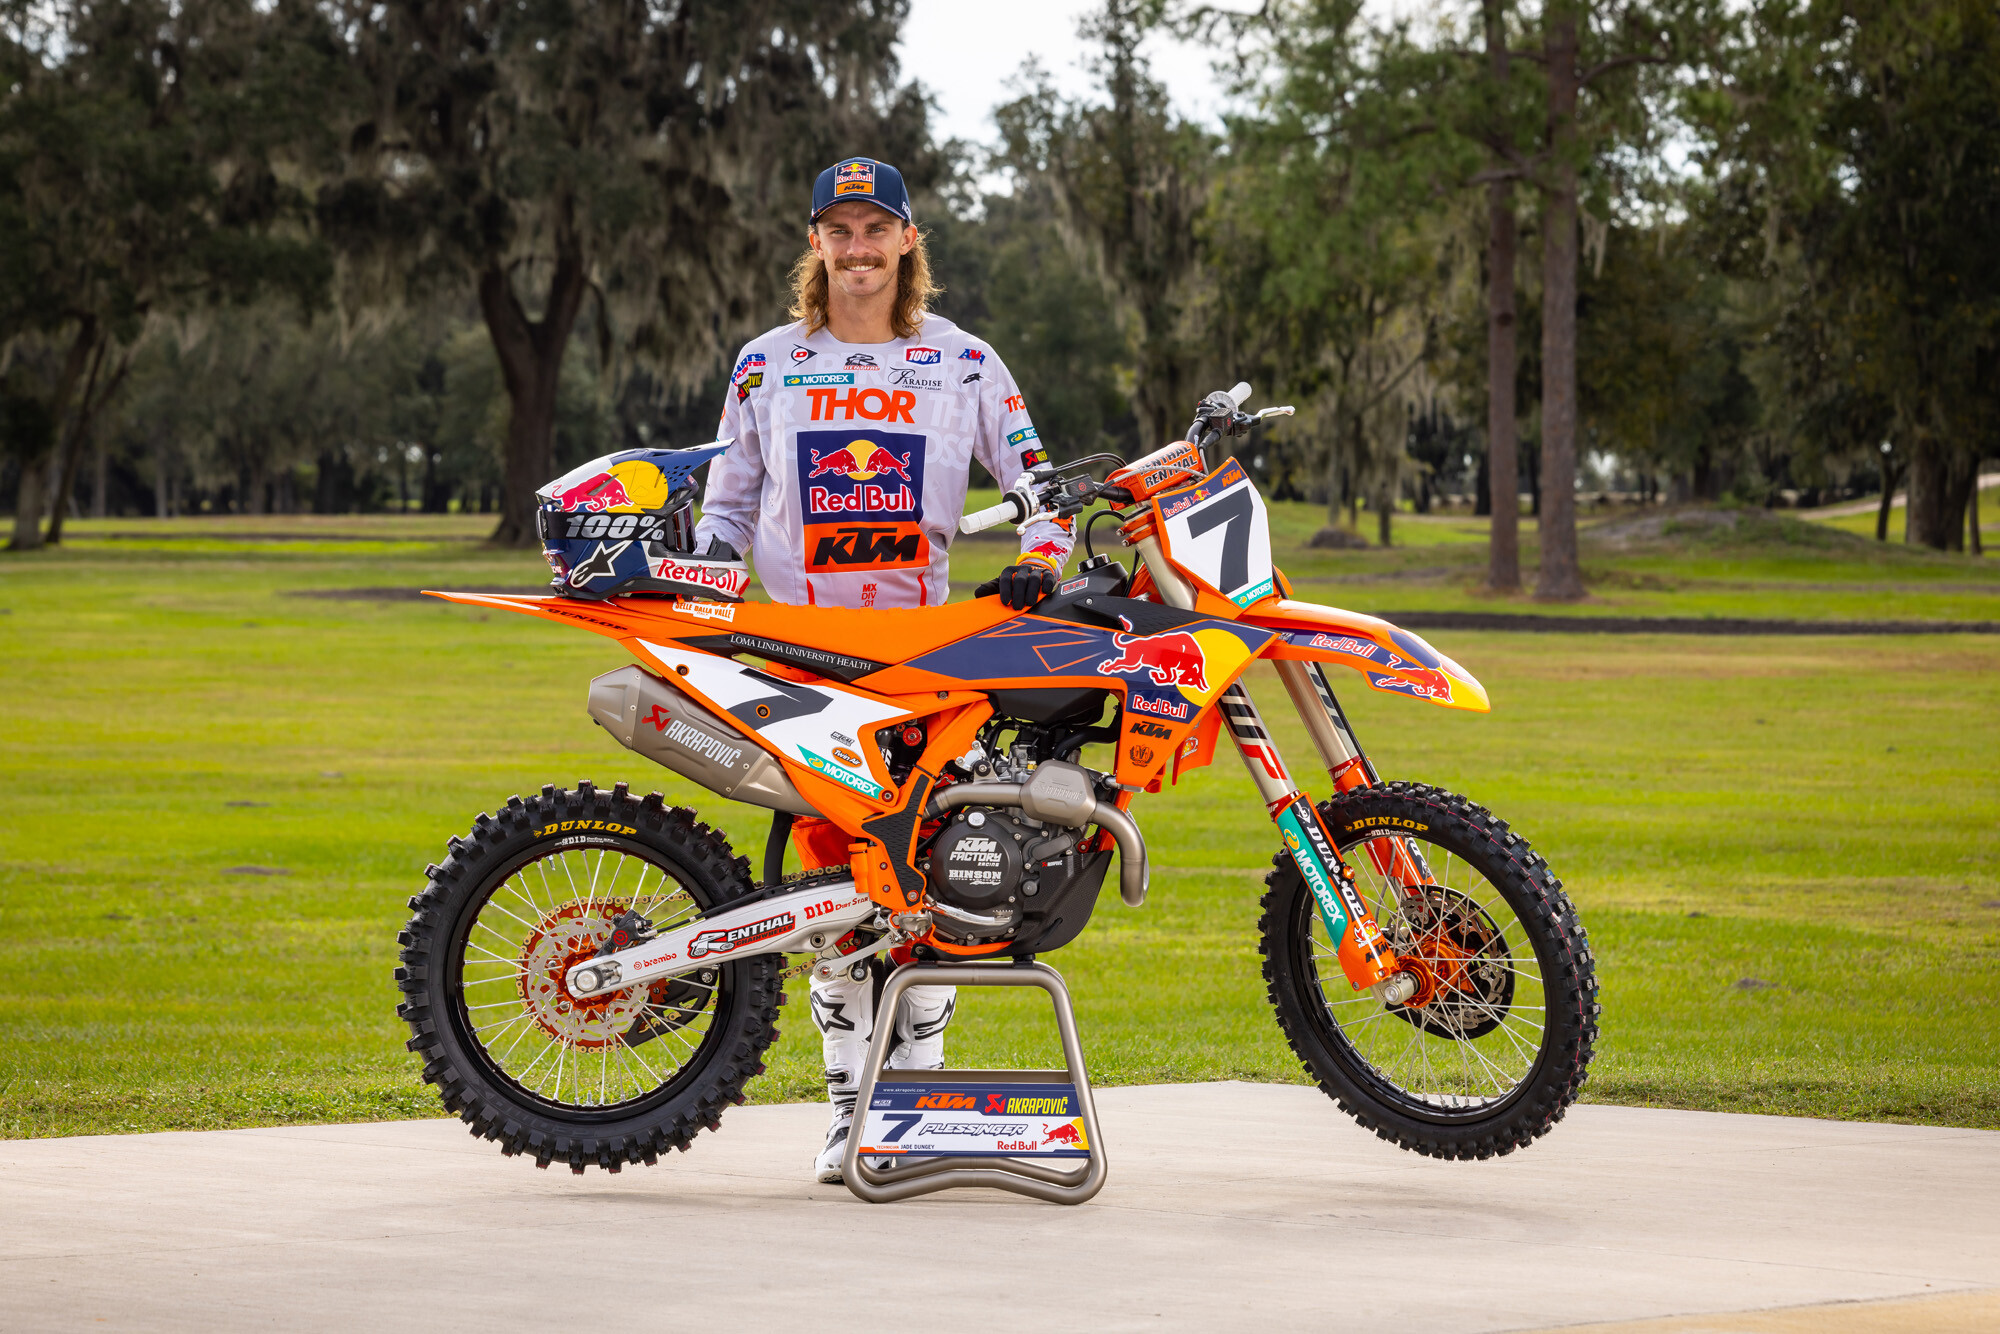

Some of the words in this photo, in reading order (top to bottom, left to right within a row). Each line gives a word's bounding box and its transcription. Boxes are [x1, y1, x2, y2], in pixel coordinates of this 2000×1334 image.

[836, 173, 854, 183] Red
[855, 172, 872, 182] Bull
[908, 350, 939, 363] 100%
[802, 374, 849, 384] MOTOREX
[888, 366, 942, 387] PARADISE
[806, 388, 916, 424] THOR
[1222, 468, 1242, 487] KTM
[809, 484, 863, 514] Red
[864, 484, 915, 512] Bull
[1163, 504, 1178, 518] Red
[1177, 497, 1192, 513] Bull
[566, 515, 666, 541] 100%
[813, 527, 920, 566] KTM
[1186, 486, 1253, 595] 7
[656, 559, 702, 584] Red
[701, 567, 738, 592] Bull
[861, 592, 877, 600] DIV
[862, 583, 877, 592] MX
[1063, 580, 1086, 592] ETS
[1247, 580, 1272, 600] MOTOREX
[548, 608, 628, 630] DUNLOP
[694, 606, 712, 614] DALLA
[715, 609, 732, 618] VALLE
[730, 635, 756, 647] LOMA
[757, 640, 784, 654] LINDA
[785, 646, 836, 664] UNIVERSITY
[837, 657, 872, 671] HEALTH
[1309, 633, 1342, 650] Red
[1340, 639, 1378, 658] Bull
[727, 668, 834, 731] 7
[1132, 695, 1160, 712] Red
[1160, 701, 1188, 719] Bull
[1130, 720, 1172, 740] KTM
[834, 749, 850, 762] Twin
[849, 758, 861, 766] Air
[823, 762, 878, 796] MOTOREX
[543, 820, 637, 836] DUNLOP
[1352, 817, 1429, 832] DUNLOP
[955, 837, 997, 852] KTM
[949, 852, 1002, 862] FACTORY
[949, 870, 1002, 879] HINSON
[1295, 849, 1343, 924] MOTOREX
[736, 924, 793, 946] CHAINWHEELS
[644, 953, 677, 967] brembo
[1365, 941, 1389, 963] KTM
[915, 1093, 977, 1109] KTM
[881, 1114, 923, 1142] 7
[918, 1123, 1028, 1136] PLESSINGER
[997, 1140, 1016, 1150] Red
[1018, 1140, 1037, 1150] Bull
